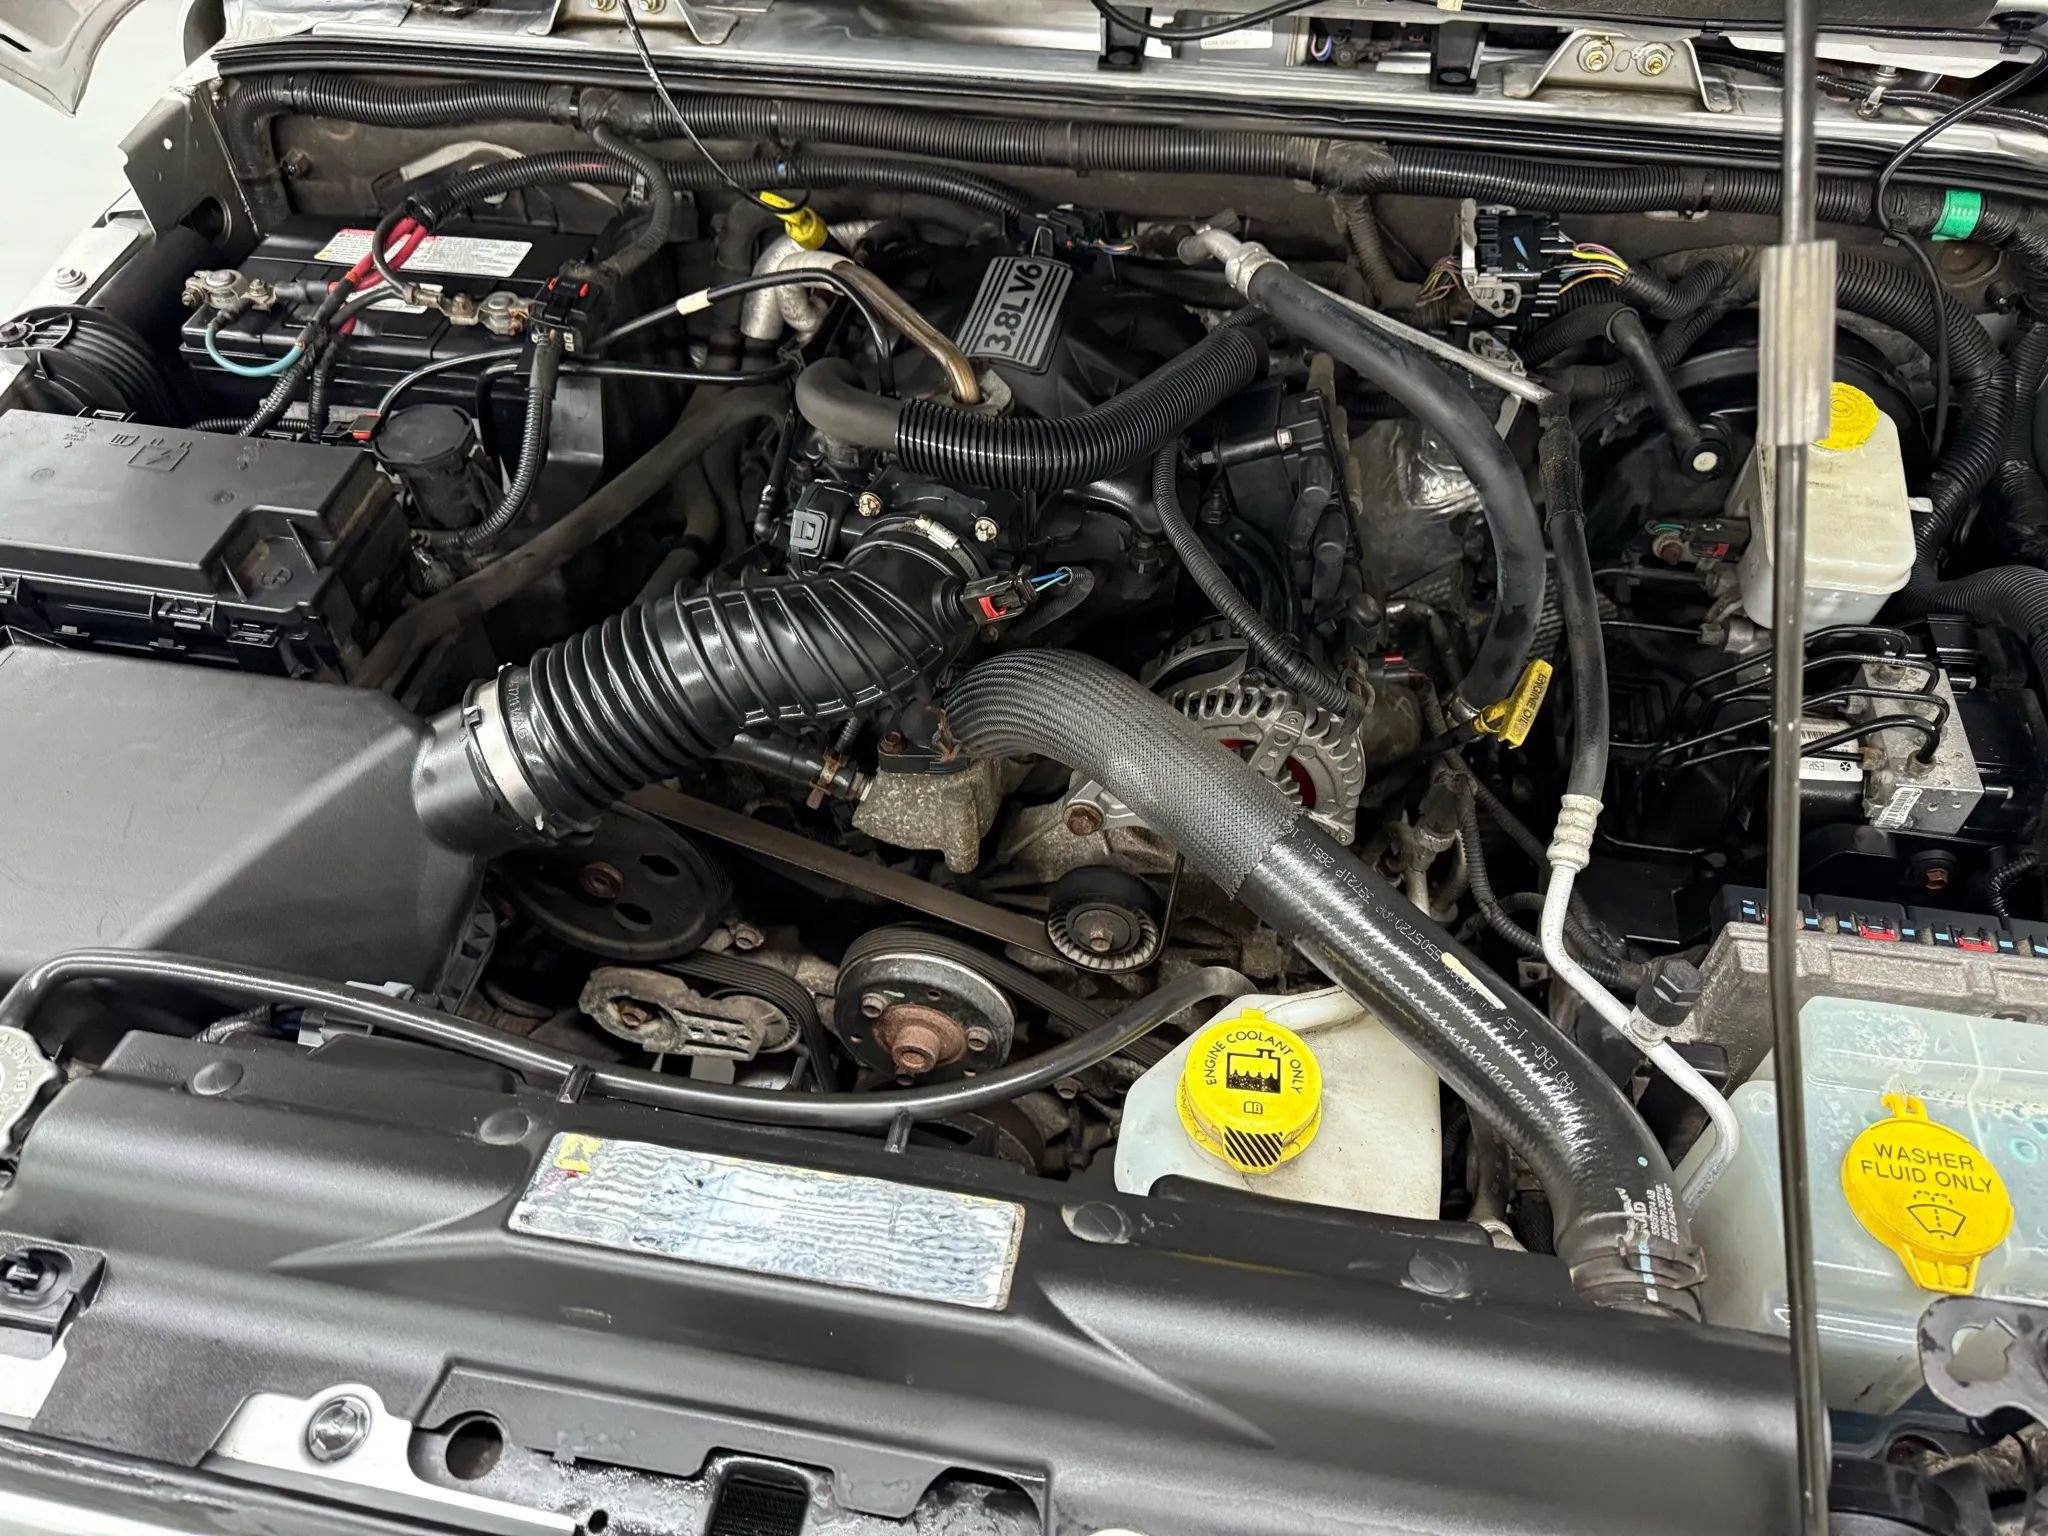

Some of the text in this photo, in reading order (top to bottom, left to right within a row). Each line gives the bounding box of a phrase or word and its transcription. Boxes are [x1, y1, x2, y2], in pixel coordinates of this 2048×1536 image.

[984, 264, 1043, 352] 3.8L V6
[1519, 673, 1547, 726] ENGINE OIL
[1204, 1030, 1305, 1094] ENGINE COOLANT ONLY
[1553, 1069, 1578, 1096] RAD
[1873, 1142, 1974, 1172] WASHER
[1861, 1159, 1992, 1193] FLUID ONLY
[1659, 1210, 1669, 1240] MOPAR
